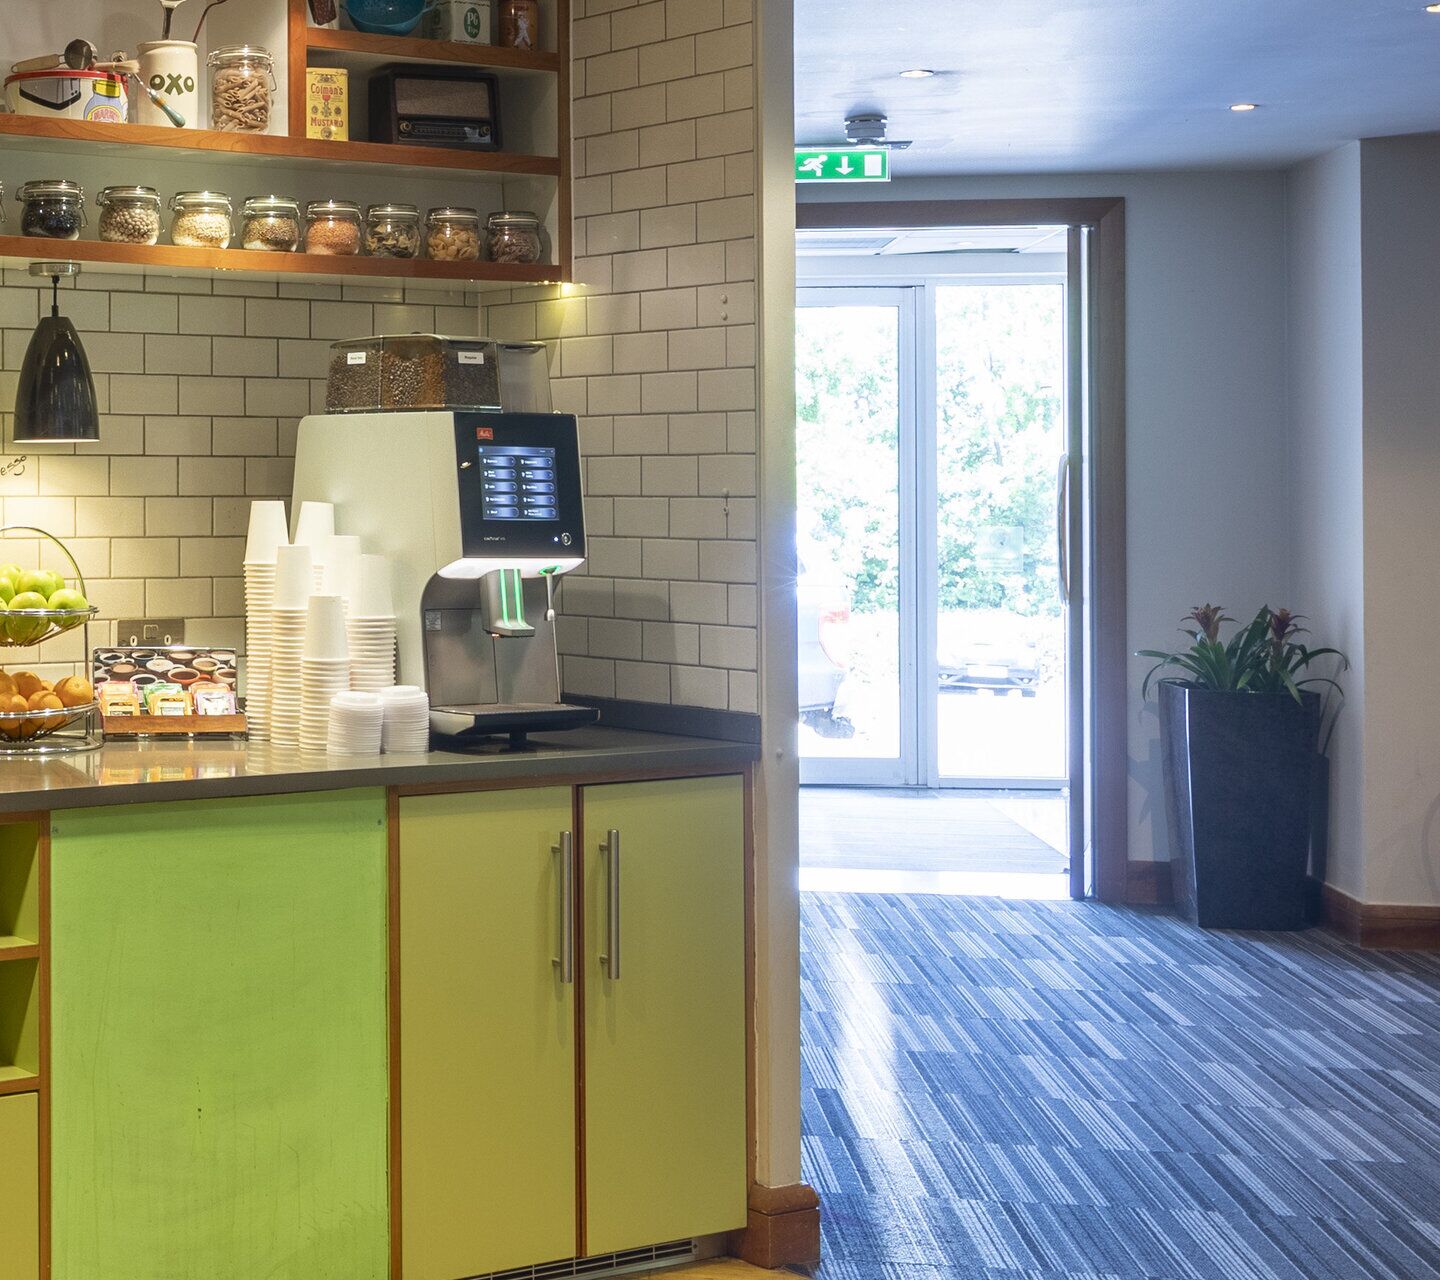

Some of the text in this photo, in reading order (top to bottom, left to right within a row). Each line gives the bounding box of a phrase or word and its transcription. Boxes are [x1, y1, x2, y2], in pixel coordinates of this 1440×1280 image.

[467, 12, 479, 25] PG
[150, 73, 194, 96] OXO
[311, 83, 343, 95] Colman's
[311, 117, 343, 128] MUSTARD
